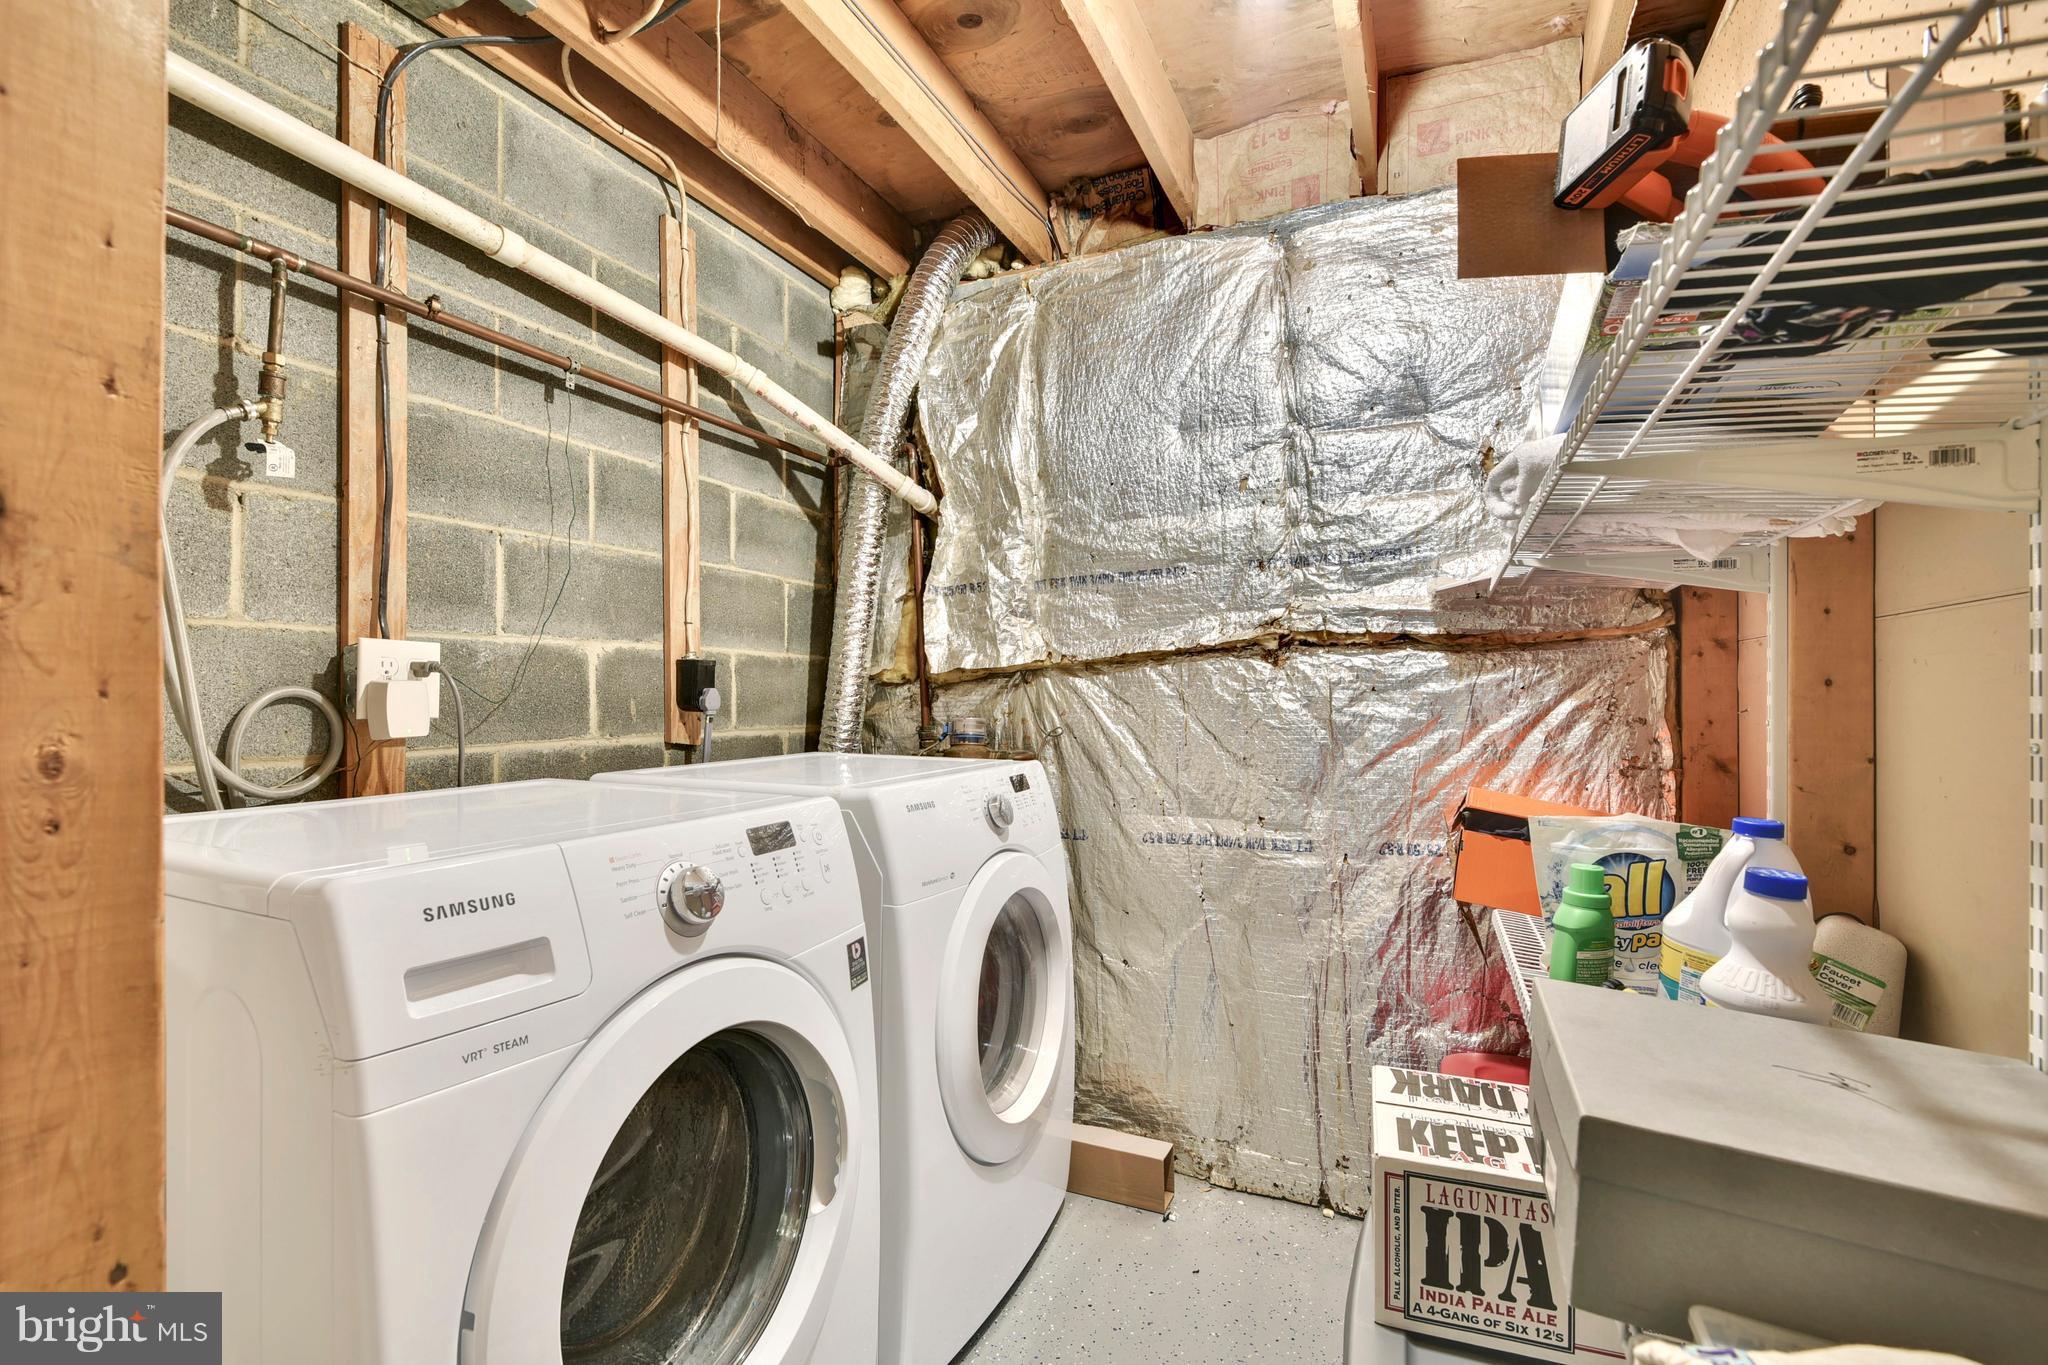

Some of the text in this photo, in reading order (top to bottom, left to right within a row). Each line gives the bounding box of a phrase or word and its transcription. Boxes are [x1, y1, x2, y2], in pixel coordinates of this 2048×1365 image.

[1251, 127, 1291, 150] R-13
[1455, 127, 1491, 145] PINK
[1600, 136, 1646, 174] LITHIUM
[1256, 185, 1286, 201] PINK
[1902, 451, 1913, 461] 12
[906, 799, 936, 813] SAMSUNG
[1603, 858, 1667, 919] all
[422, 892, 516, 922] SAMSUNG
[1819, 972, 1854, 991] Cover
[1822, 965, 1862, 987] Faucet
[493, 1034, 529, 1055] STEAM
[1391, 1068, 1518, 1112] DARK
[1396, 1117, 1519, 1165] KEEP
[1426, 1183, 1550, 1225] LAGUNITAS
[1420, 1205, 1558, 1311] IPA
[1412, 1302, 1424, 1315] A
[1483, 1316, 1502, 1330] OF
[1472, 1296, 1516, 1318] PALE
[1522, 1308, 1558, 1328] ALE
